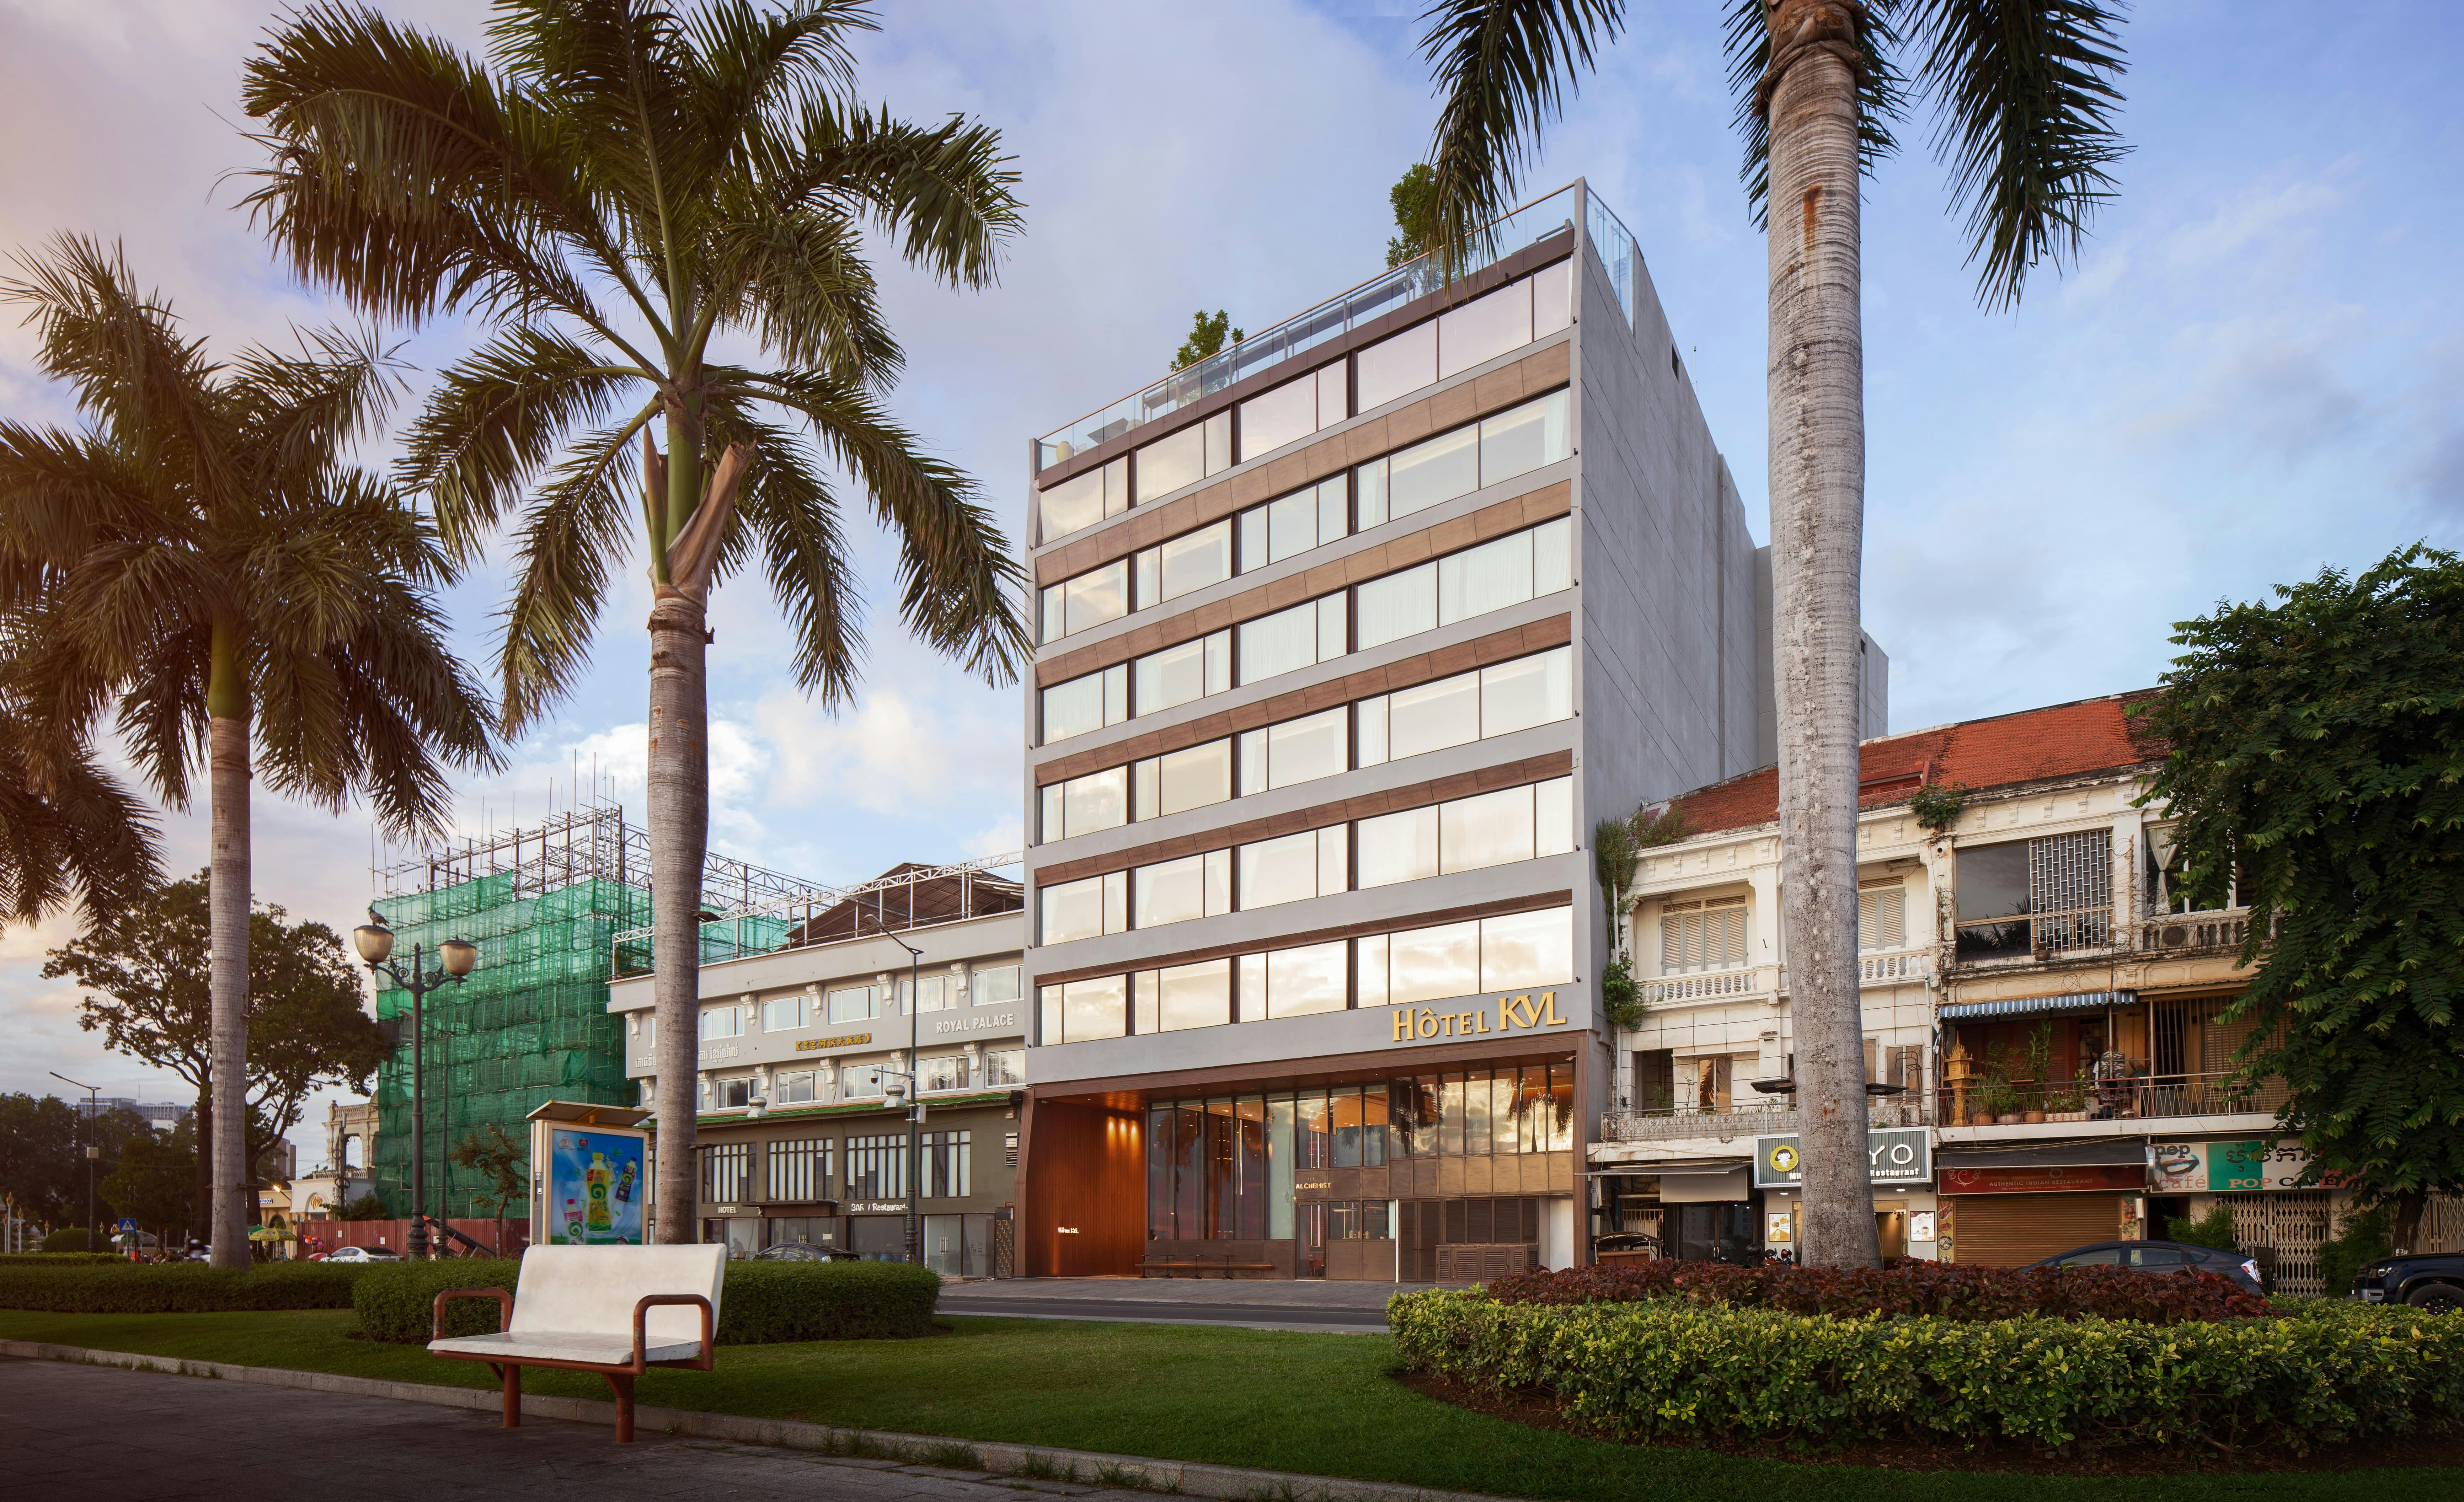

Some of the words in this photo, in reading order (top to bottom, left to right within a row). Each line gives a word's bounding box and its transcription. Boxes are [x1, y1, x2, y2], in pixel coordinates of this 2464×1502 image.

[1498, 991, 1567, 1031] KVL
[936, 1019, 970, 1034] ROYAL
[973, 1014, 1014, 1030] PALACE
[802, 1034, 863, 1050] 皇宫河滨大饭店
[1869, 1144, 1913, 1165] YO
[1870, 1168, 1919, 1177] Restaurant
[2159, 1175, 2206, 1189] café
[2229, 1178, 2272, 1188] POP
[2279, 1174, 2337, 1187] CÉ
[872, 1203, 908, 1211] Restaurant
